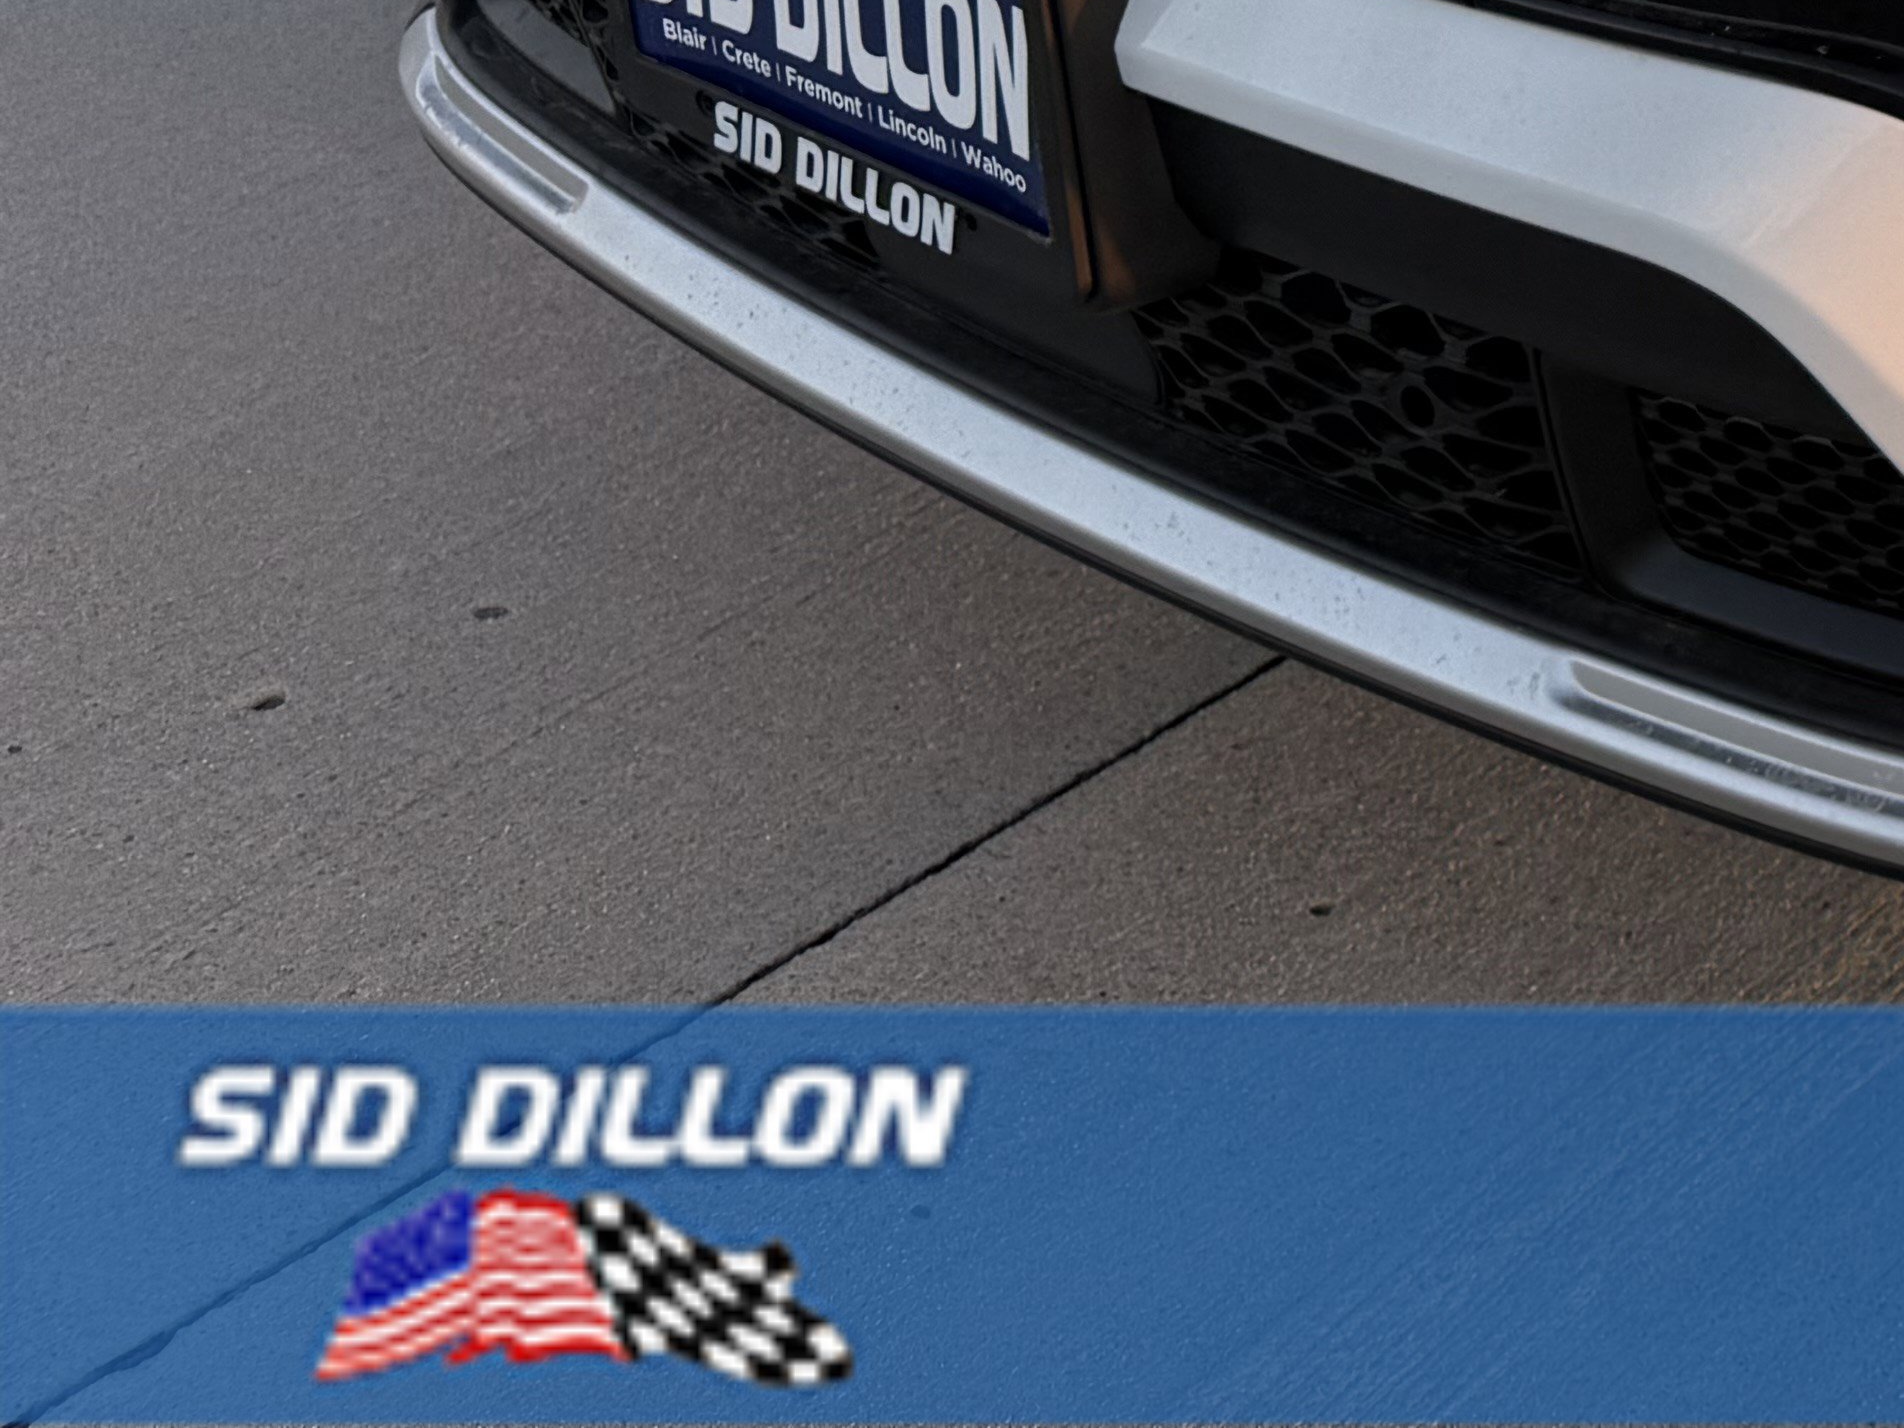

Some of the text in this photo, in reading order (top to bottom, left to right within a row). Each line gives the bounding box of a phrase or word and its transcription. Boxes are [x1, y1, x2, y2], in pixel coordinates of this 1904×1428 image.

[662, 17, 1027, 193] Blair Crete Fremont Lincoln Wahoo
[713, 101, 956, 256] SID DILLON
